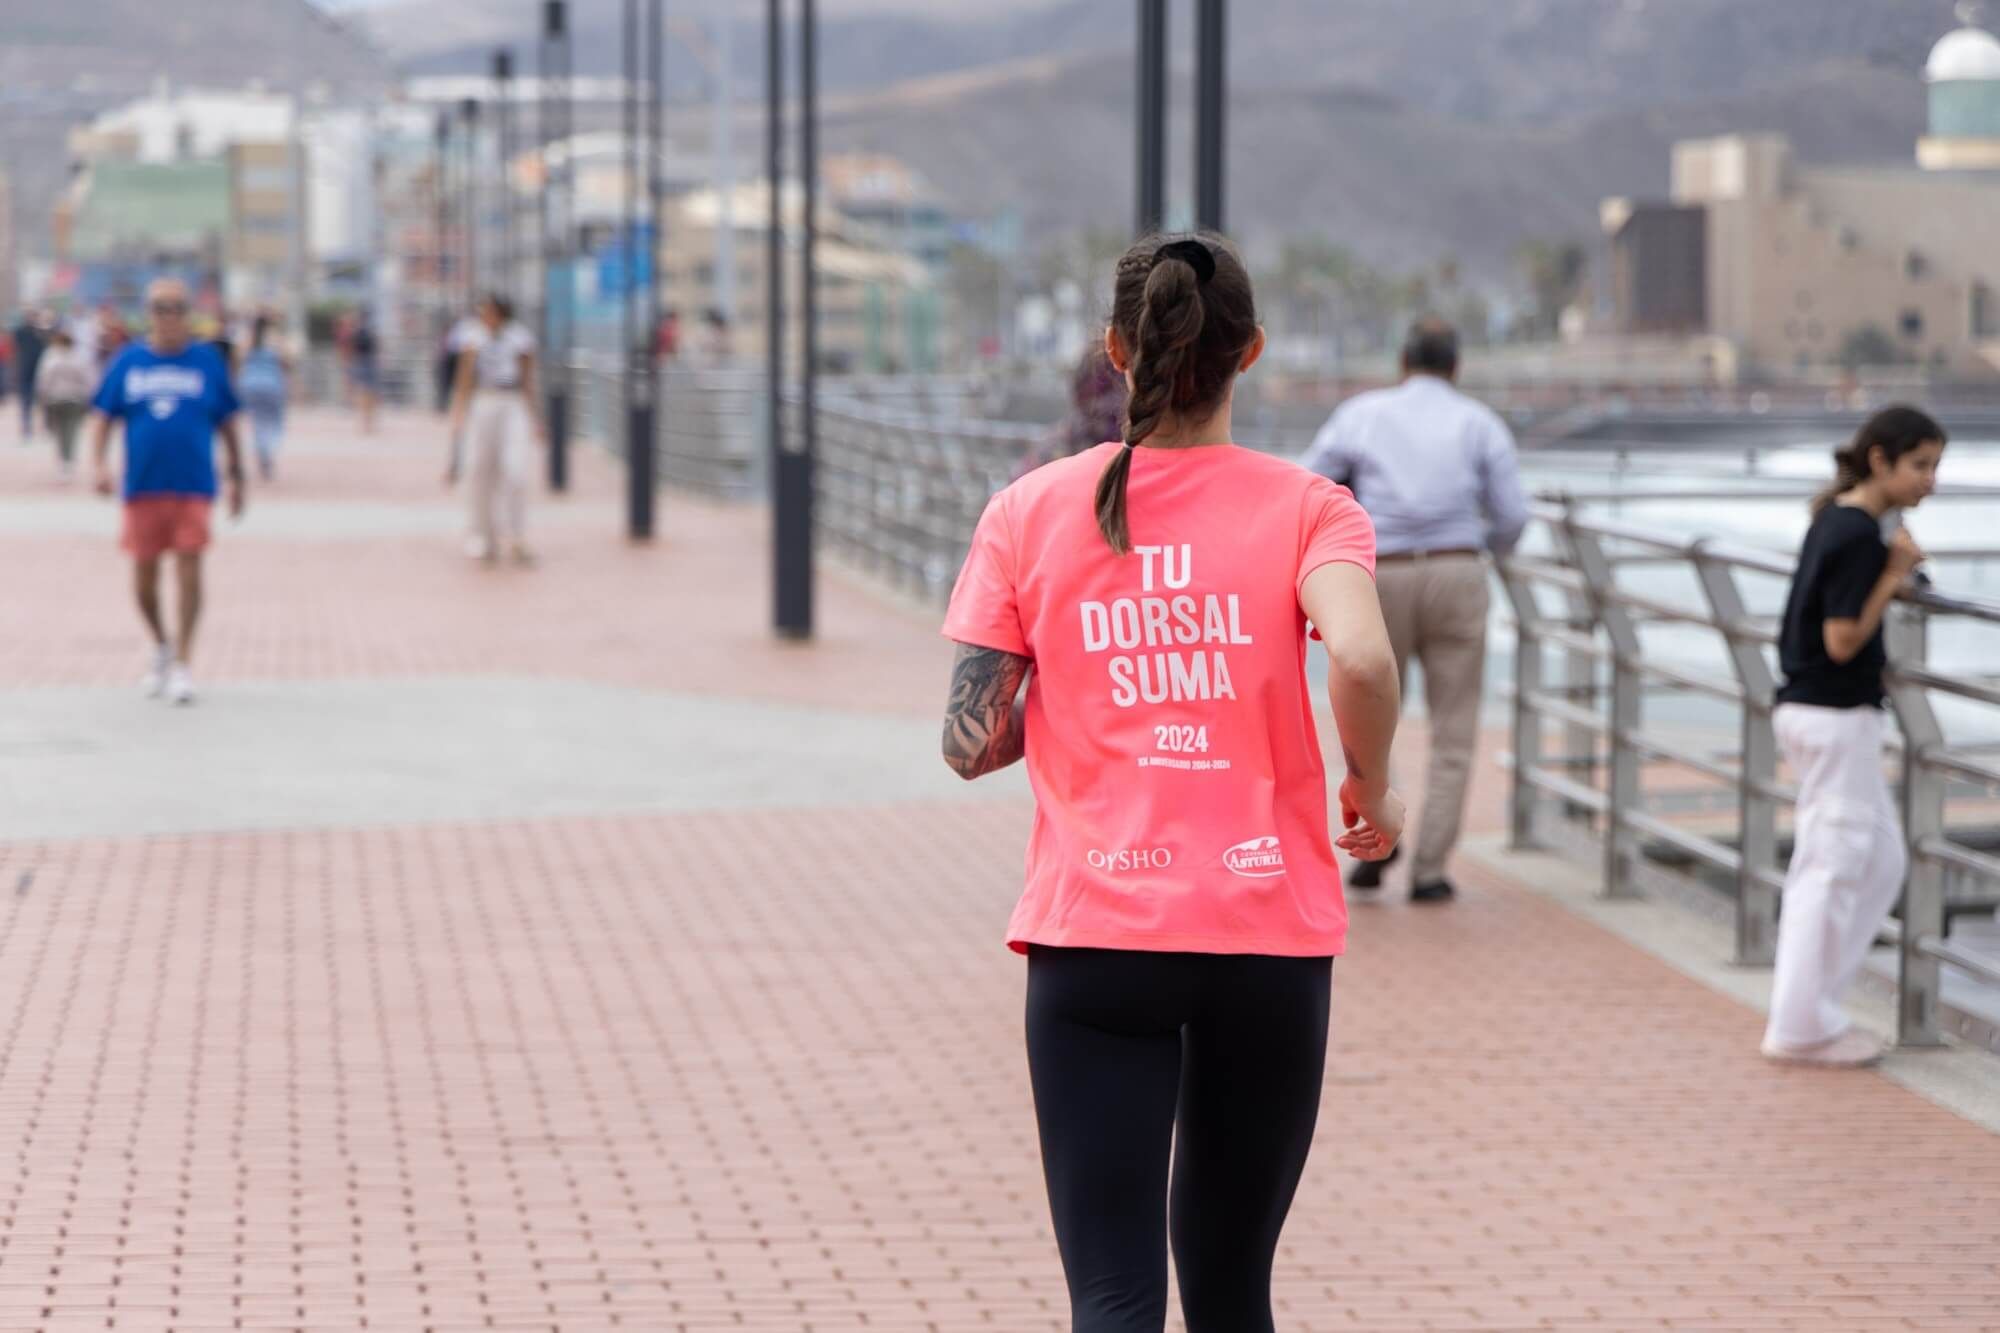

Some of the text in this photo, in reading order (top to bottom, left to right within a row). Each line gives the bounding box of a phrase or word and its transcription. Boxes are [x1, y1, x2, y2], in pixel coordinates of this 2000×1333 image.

[1134, 543, 1191, 592] TU
[1079, 594, 1253, 652] DORSAL
[1108, 650, 1237, 708] SUMA
[1153, 725, 1209, 753] 2024
[1087, 848, 1172, 872] OYSHO
